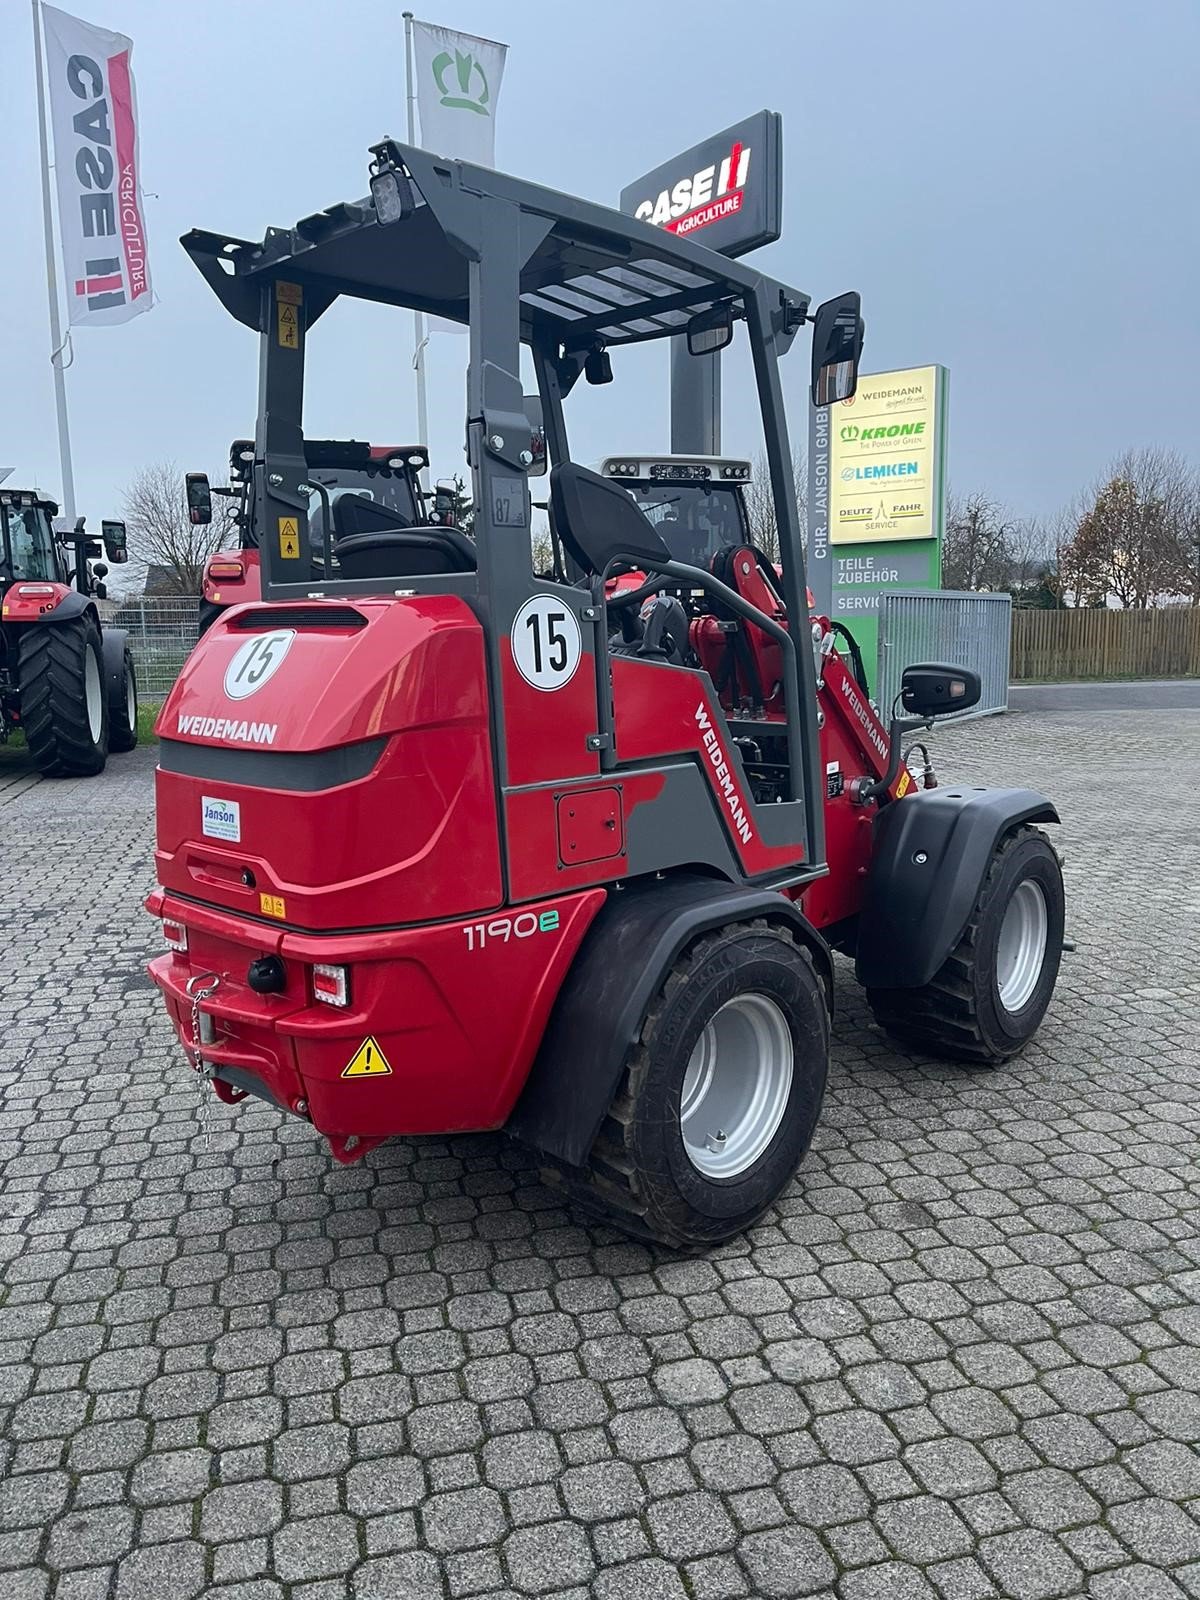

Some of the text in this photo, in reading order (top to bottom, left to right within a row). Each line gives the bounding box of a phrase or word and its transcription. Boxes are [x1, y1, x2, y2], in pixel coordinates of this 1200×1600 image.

[635, 165, 716, 226] CASE
[676, 196, 739, 235] AGRICULTURE
[862, 386, 922, 401] WEIDEMANN
[861, 422, 926, 440] KRONE
[856, 461, 918, 480] LEMKEN
[815, 453, 828, 517] JANSON
[495, 497, 510, 523] 87
[840, 504, 921, 517] DEUTZ FAHR
[865, 521, 898, 530] SERVICE
[814, 522, 827, 559] CHR.
[838, 557, 874, 570] TEILE
[838, 568, 898, 584] ZUBEHÖR
[838, 596, 892, 609] SERVI
[526, 612, 568, 673] 15
[234, 636, 288, 685] 15
[177, 714, 278, 745] WEIDEMANN
[840, 676, 889, 760] WEIDEMANN
[694, 702, 752, 844] WEIDEMANN
[205, 806, 234, 823] Janson
[463, 910, 560, 951] 1190e
